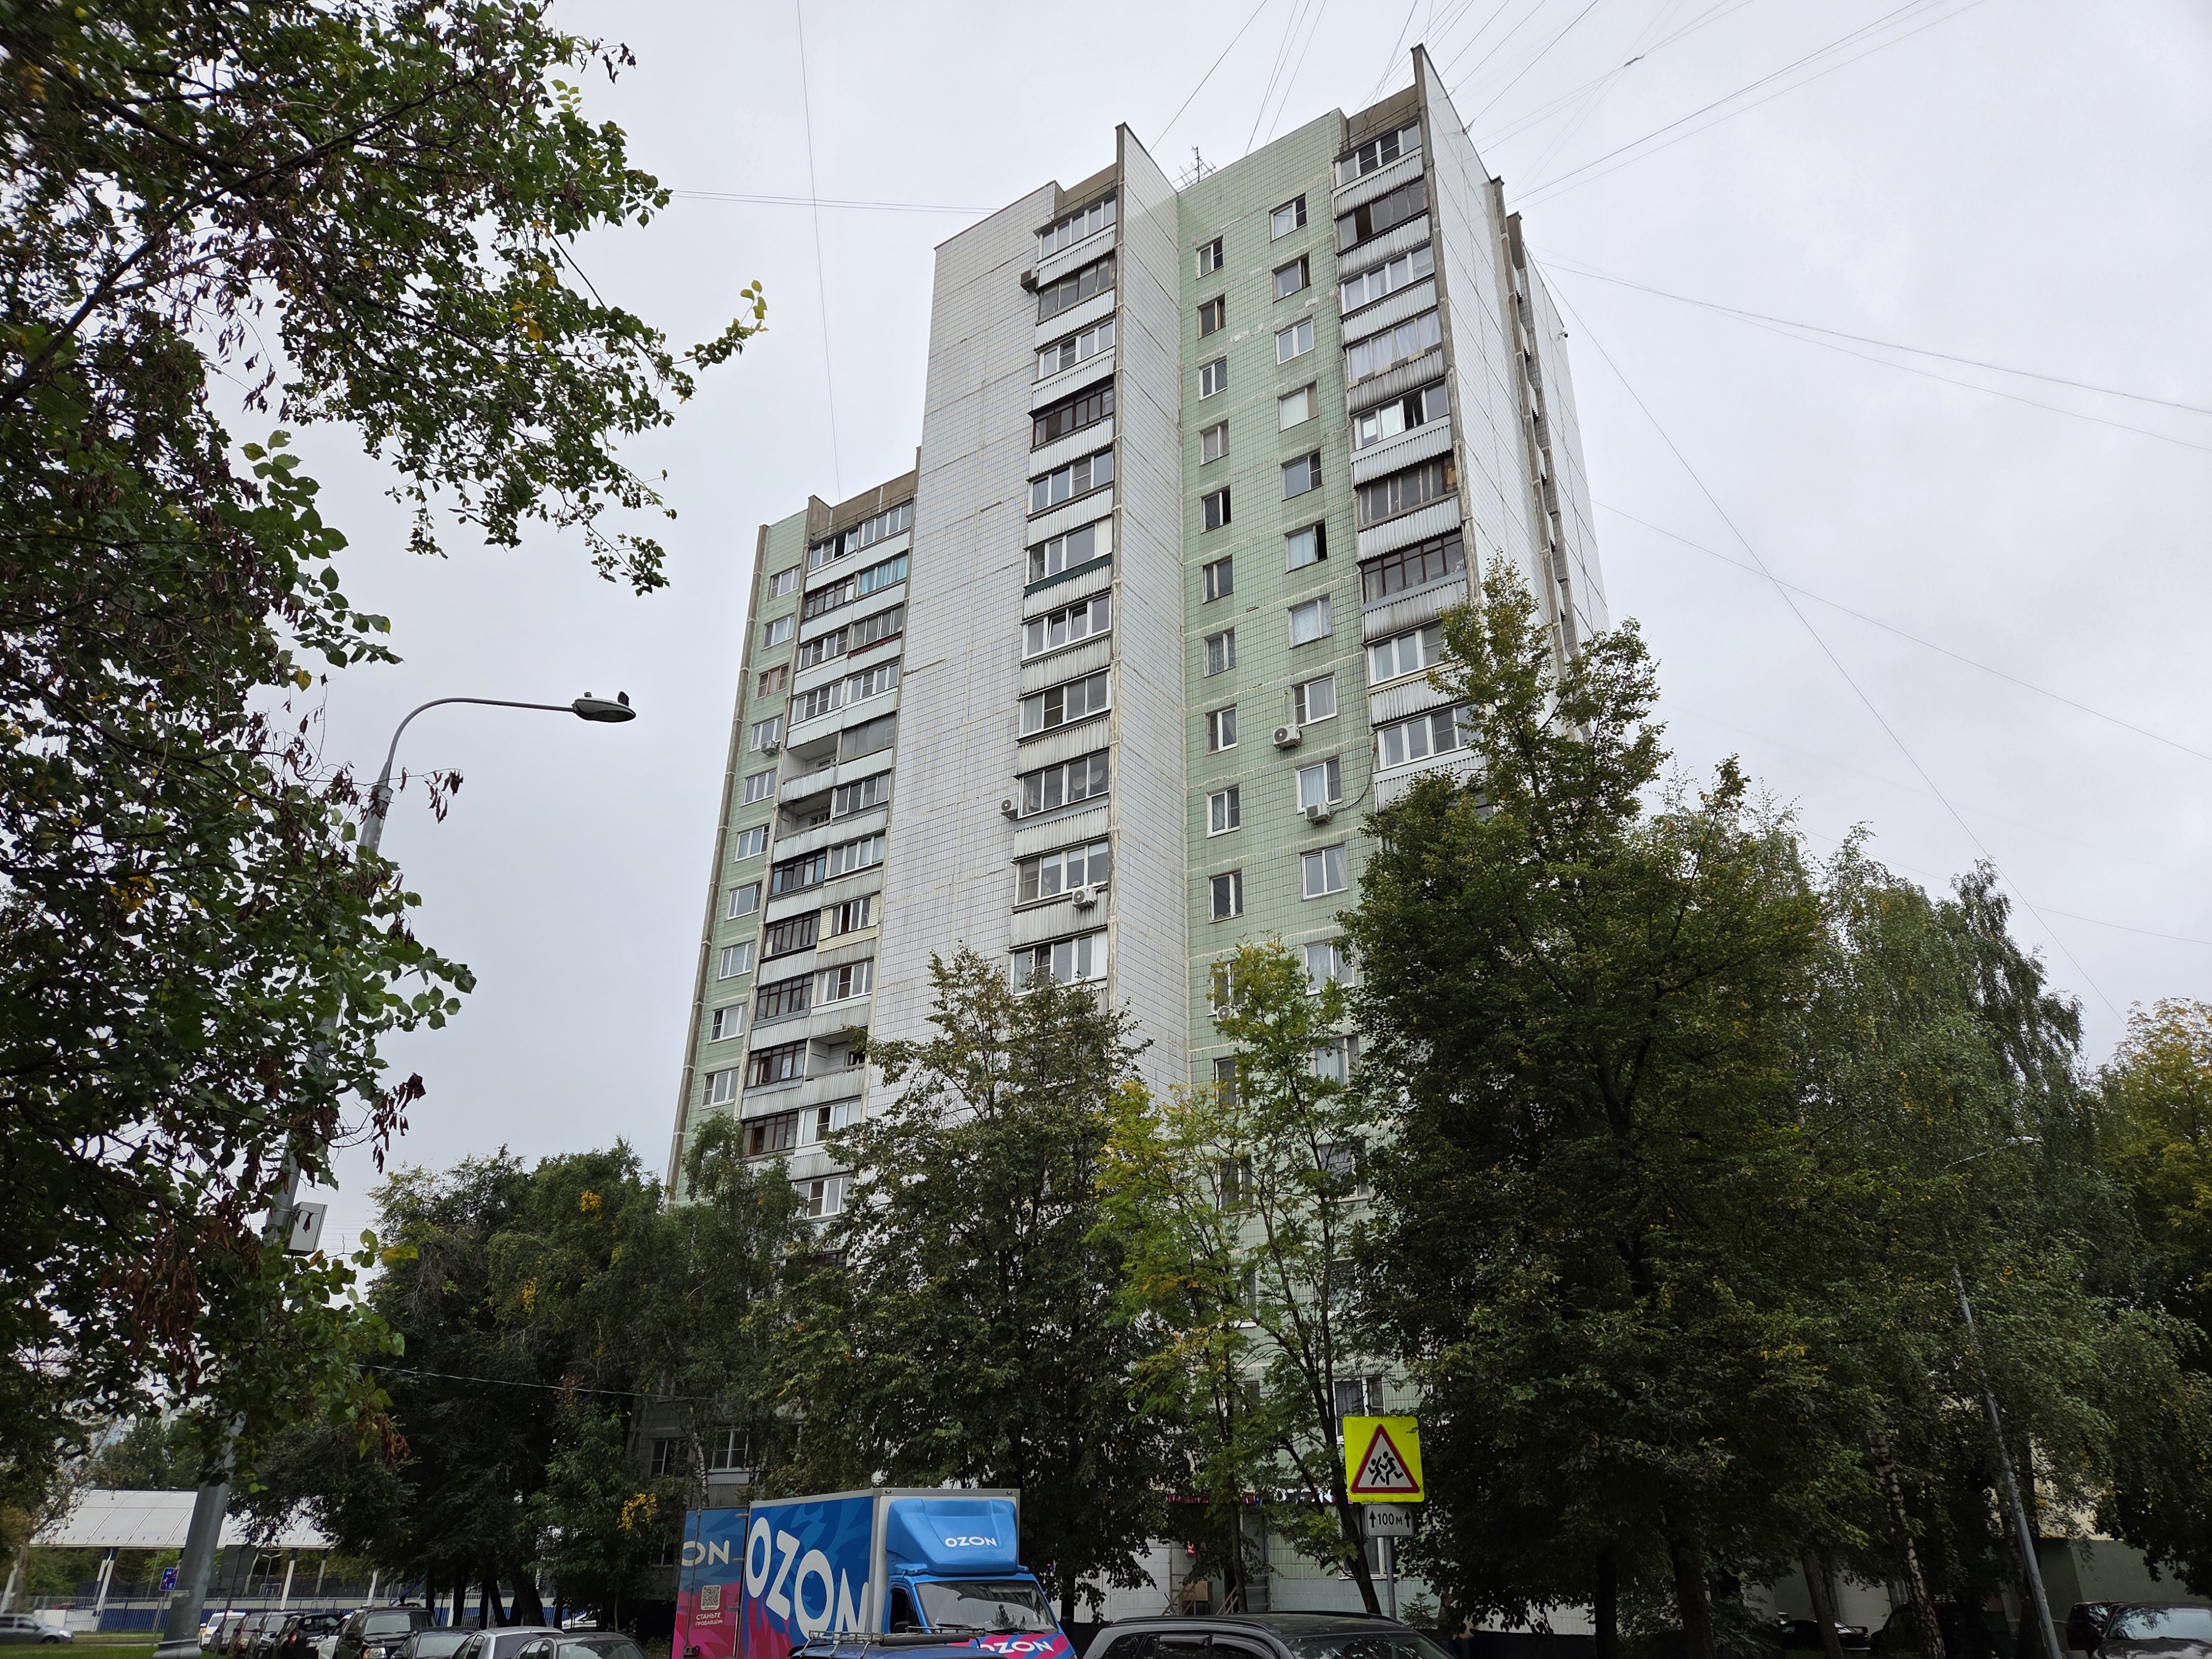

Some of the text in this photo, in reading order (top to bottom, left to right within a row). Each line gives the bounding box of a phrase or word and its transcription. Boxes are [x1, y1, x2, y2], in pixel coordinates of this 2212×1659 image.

[945, 1536, 997, 1547] OZON
[746, 1517, 869, 1644] OZON
[696, 1612, 721, 1620] СТАНЬТЕ
